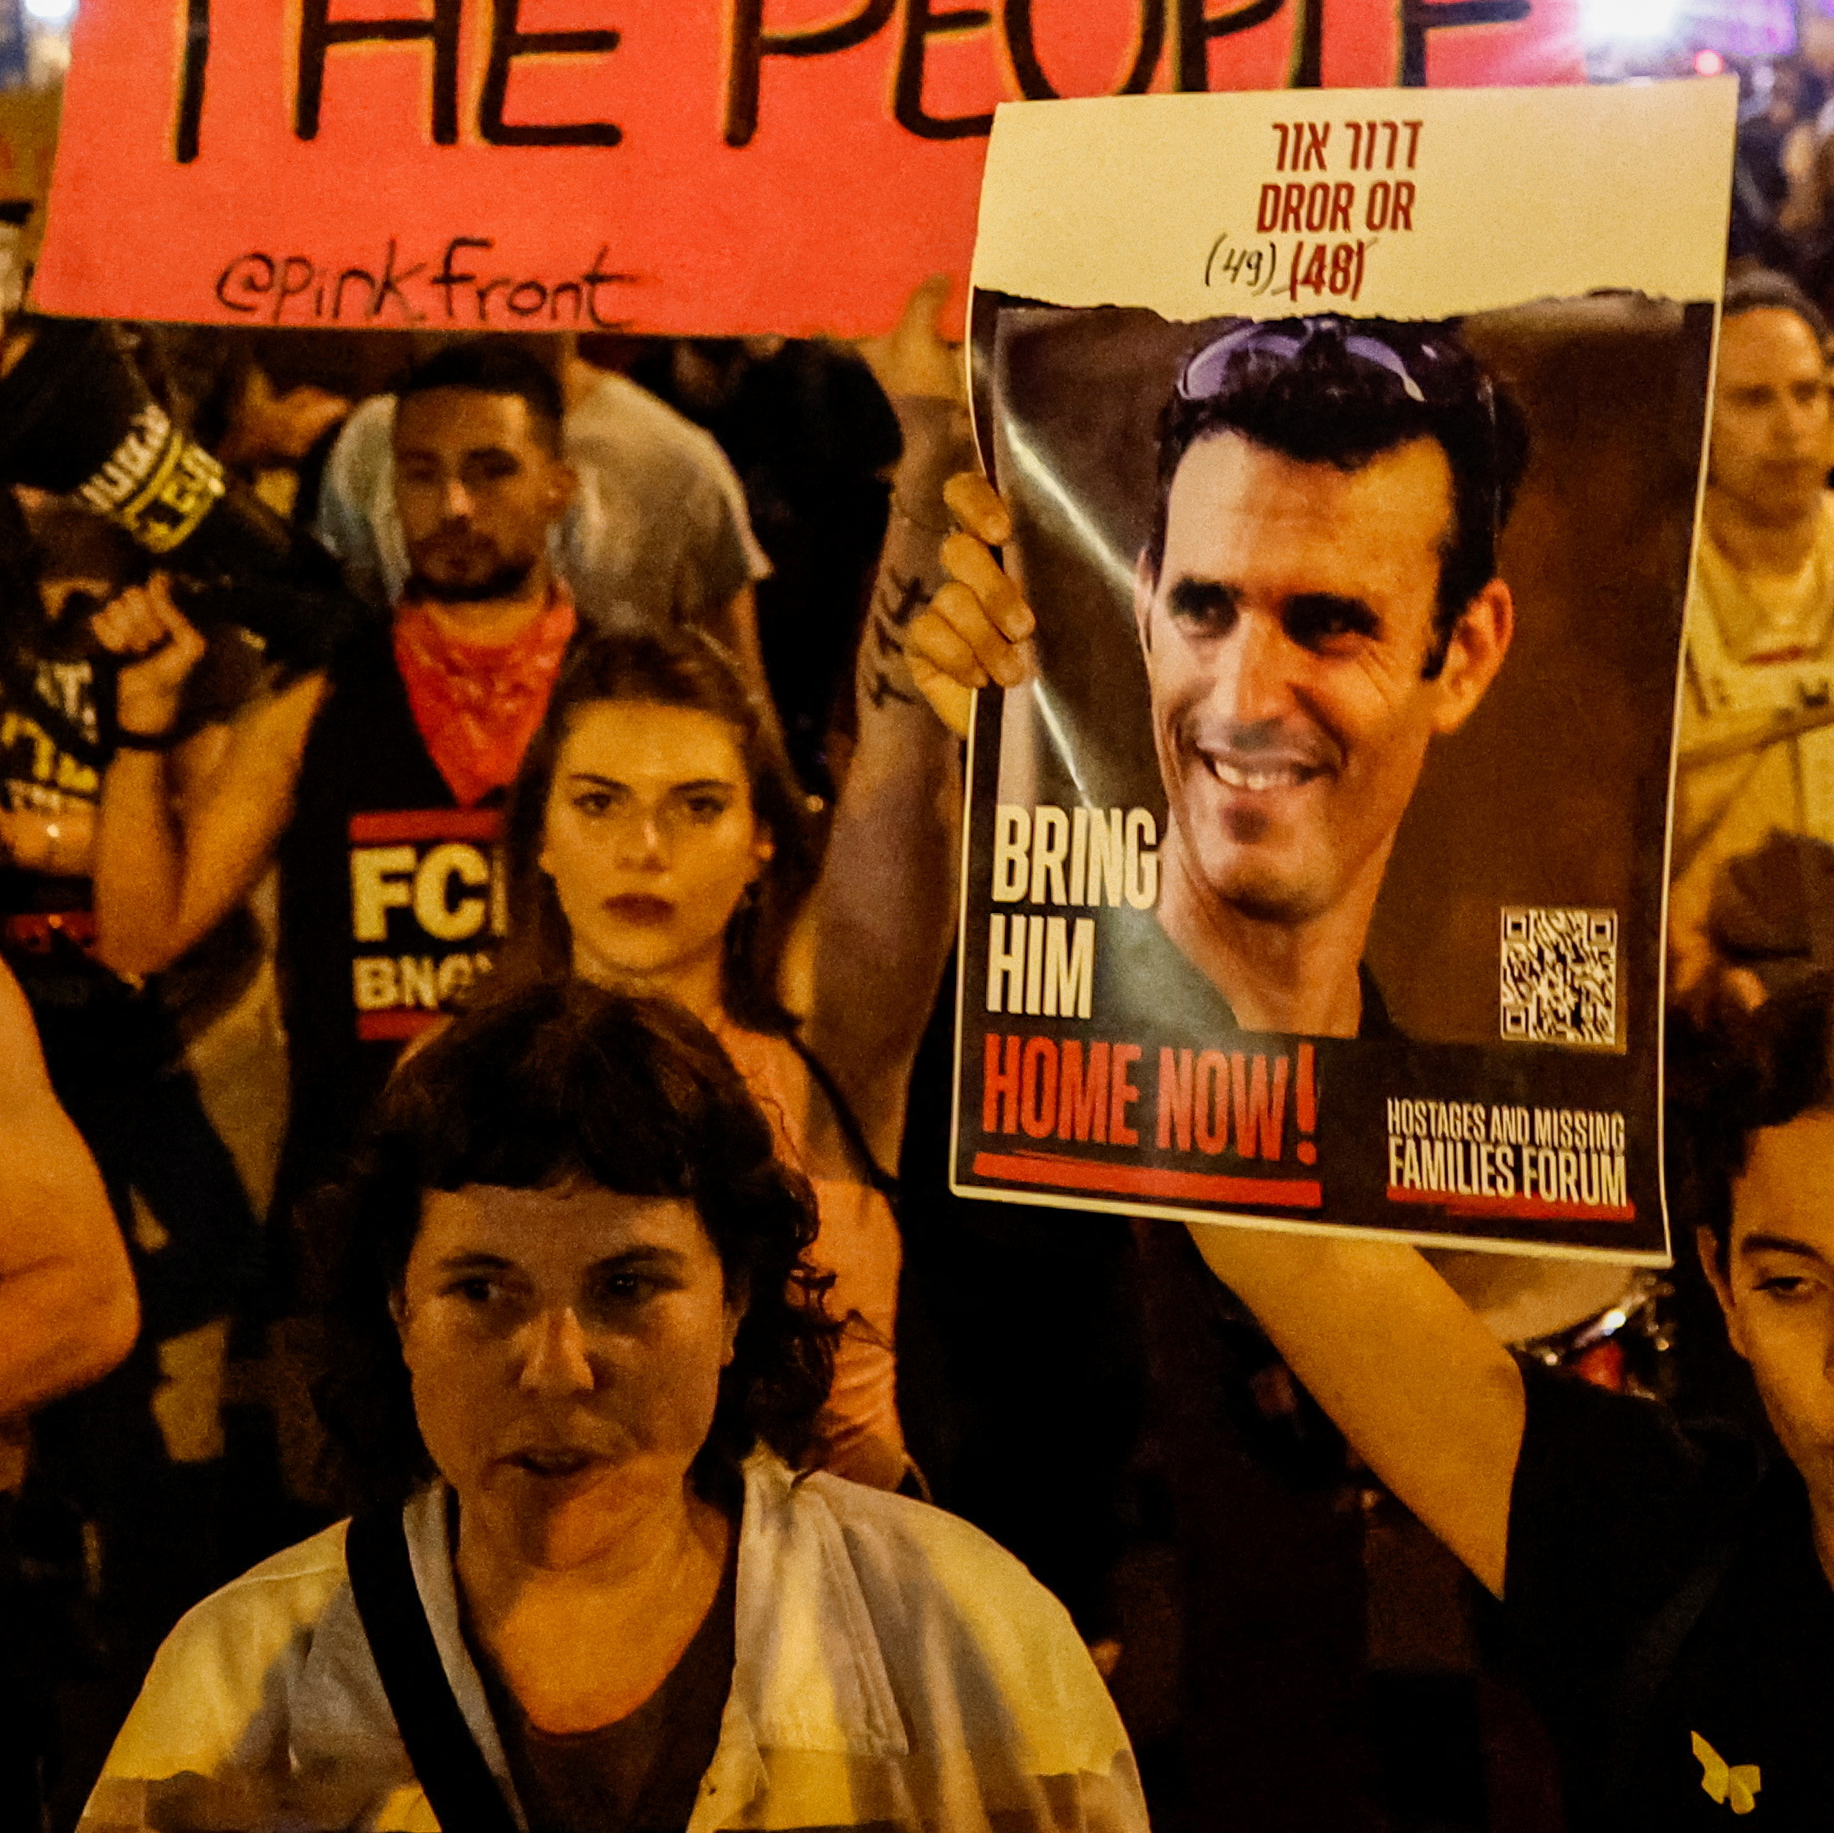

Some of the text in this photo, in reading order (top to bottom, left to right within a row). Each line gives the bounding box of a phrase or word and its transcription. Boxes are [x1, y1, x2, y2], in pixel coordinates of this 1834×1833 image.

[1272, 120, 1423, 172] דרור אור
[1256, 180, 1416, 233] DROR OR
[1205, 232, 1277, 297] (49)
[1289, 239, 1366, 302] (48)
[991, 804, 1159, 910] BRING
[350, 843, 508, 941] FC
[986, 913, 1095, 1019] HIM
[981, 1033, 1317, 1165] HOME NOW!
[1387, 1096, 1625, 1156] HOSTAGES AND MISSING
[1389, 1135, 1627, 1207] FAMILIES FORUM
